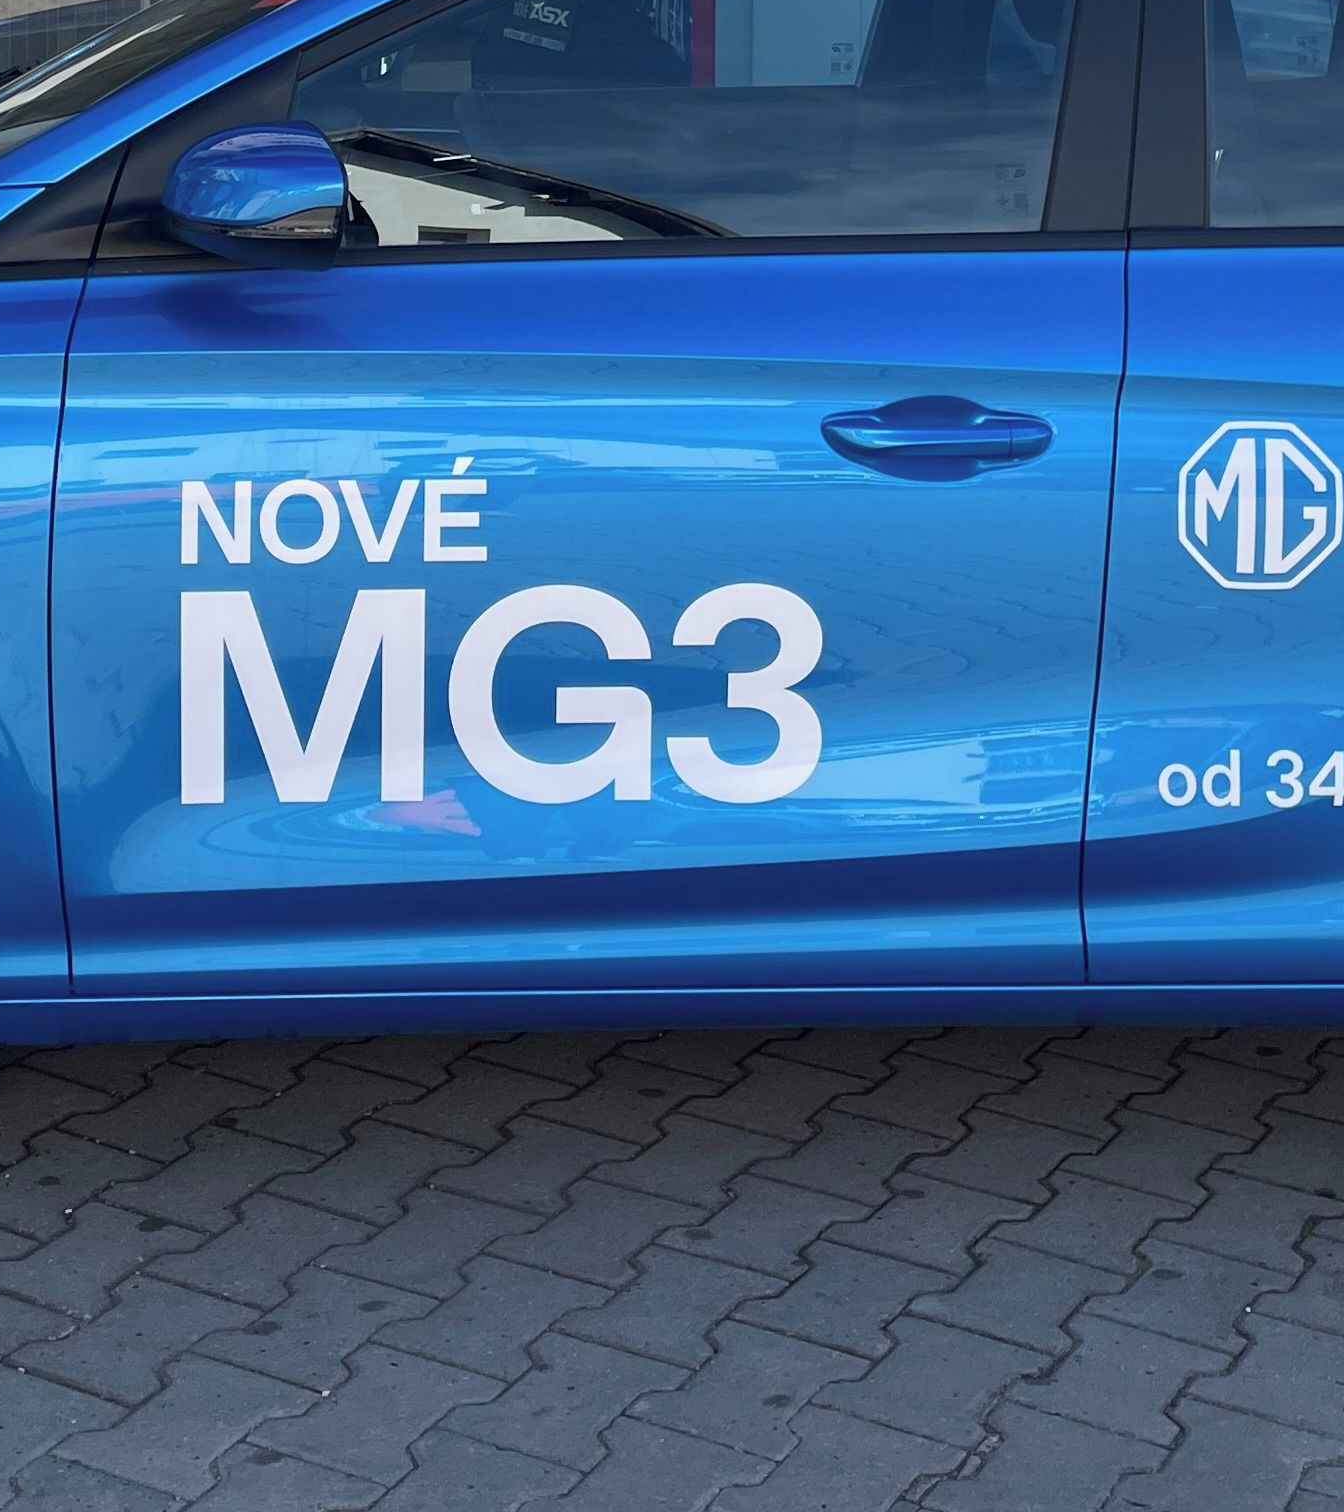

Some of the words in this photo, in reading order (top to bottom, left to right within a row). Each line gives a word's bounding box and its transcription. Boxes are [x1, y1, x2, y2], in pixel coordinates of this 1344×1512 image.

[180, 457, 487, 565] NOVÉ
[1187, 429, 1335, 581] MG
[180, 583, 823, 804] MG3
[1157, 749, 1242, 807] od
